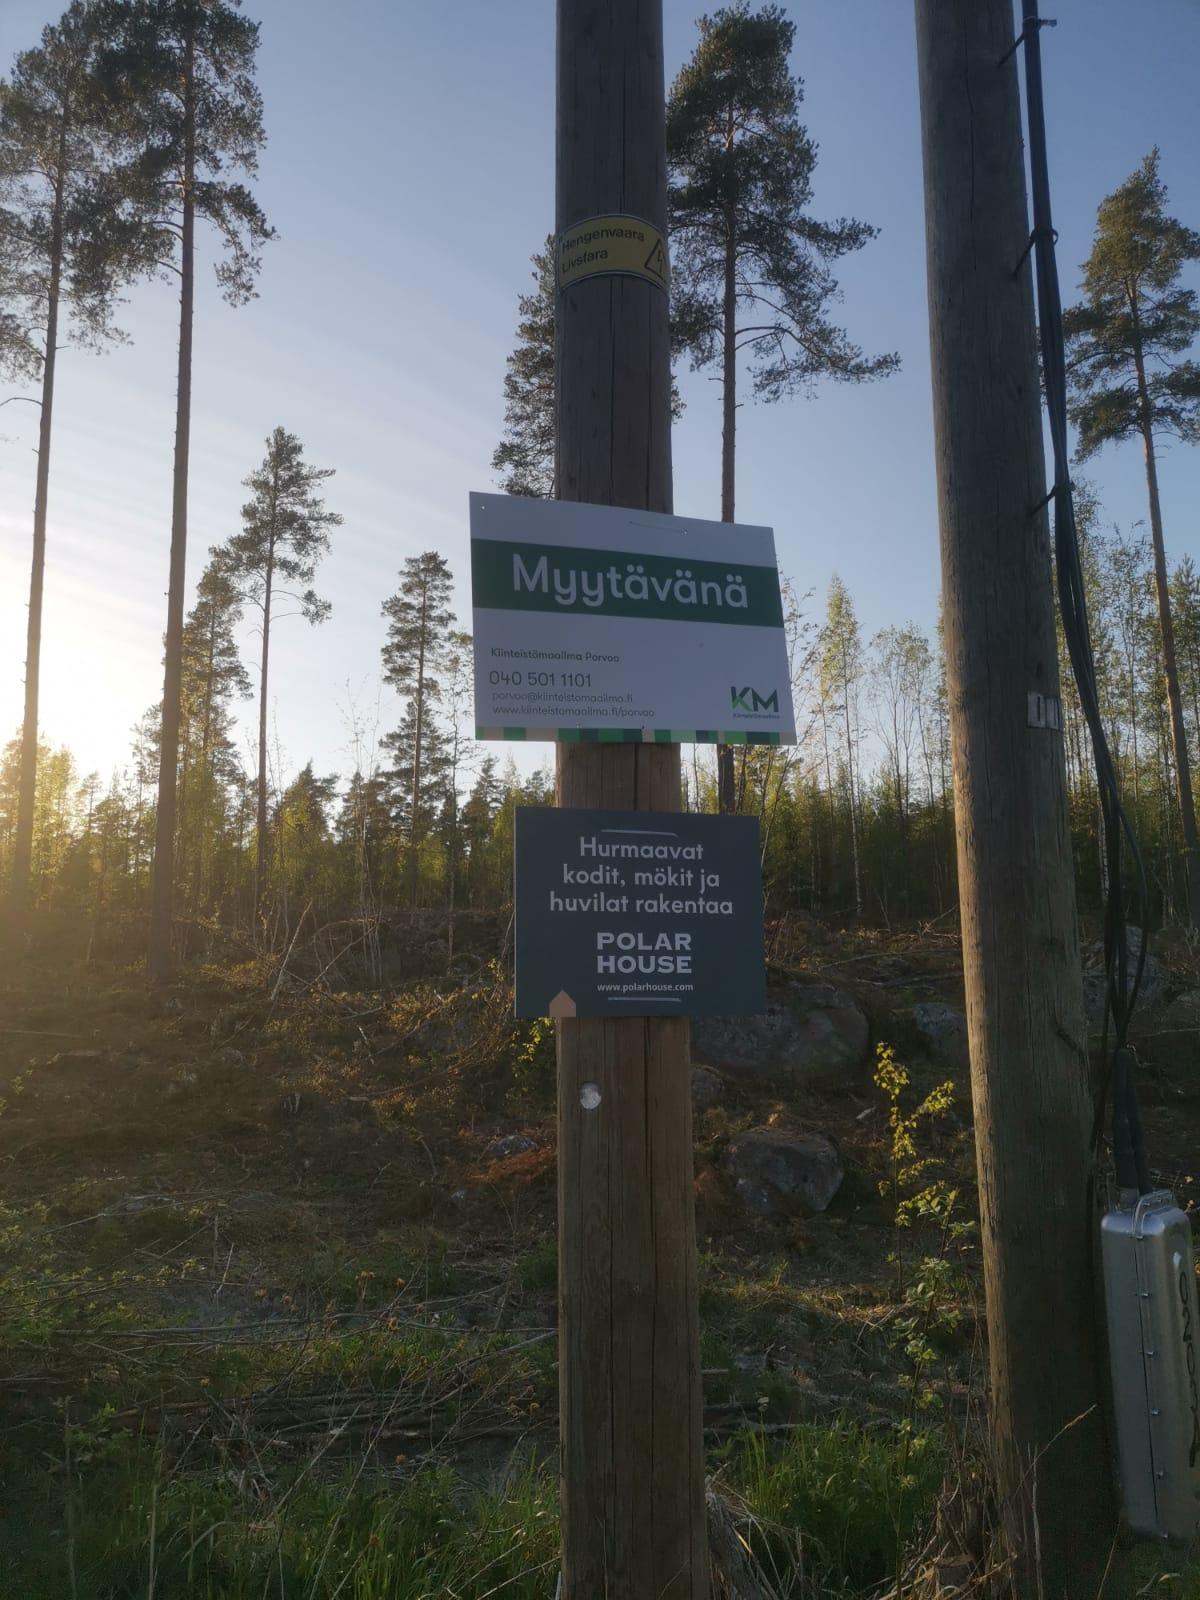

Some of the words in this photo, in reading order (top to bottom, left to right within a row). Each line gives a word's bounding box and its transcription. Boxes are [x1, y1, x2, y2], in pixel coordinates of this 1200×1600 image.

[562, 228, 645, 255] Hengenvaara
[562, 248, 609, 273] Livsfara
[512, 553, 748, 608] Myytävänä
[491, 648, 582, 661] Kiinteistömaailma
[585, 652, 620, 663] Porvoo
[489, 670, 522, 686] 040
[527, 672, 555, 687] 501
[561, 672, 592, 688] 1101
[730, 685, 779, 713] KM
[580, 836, 704, 860] Hurmaavat
[563, 864, 626, 887] kodit,
[634, 866, 693, 887] mökit
[700, 869, 720, 894] ja
[550, 891, 628, 913] huvilat
[636, 893, 733, 915] rakentaa
[596, 932, 692, 951] POLAR
[596, 955, 692, 974] HOUSE
[597, 982, 694, 993] www.polarhouse.com
